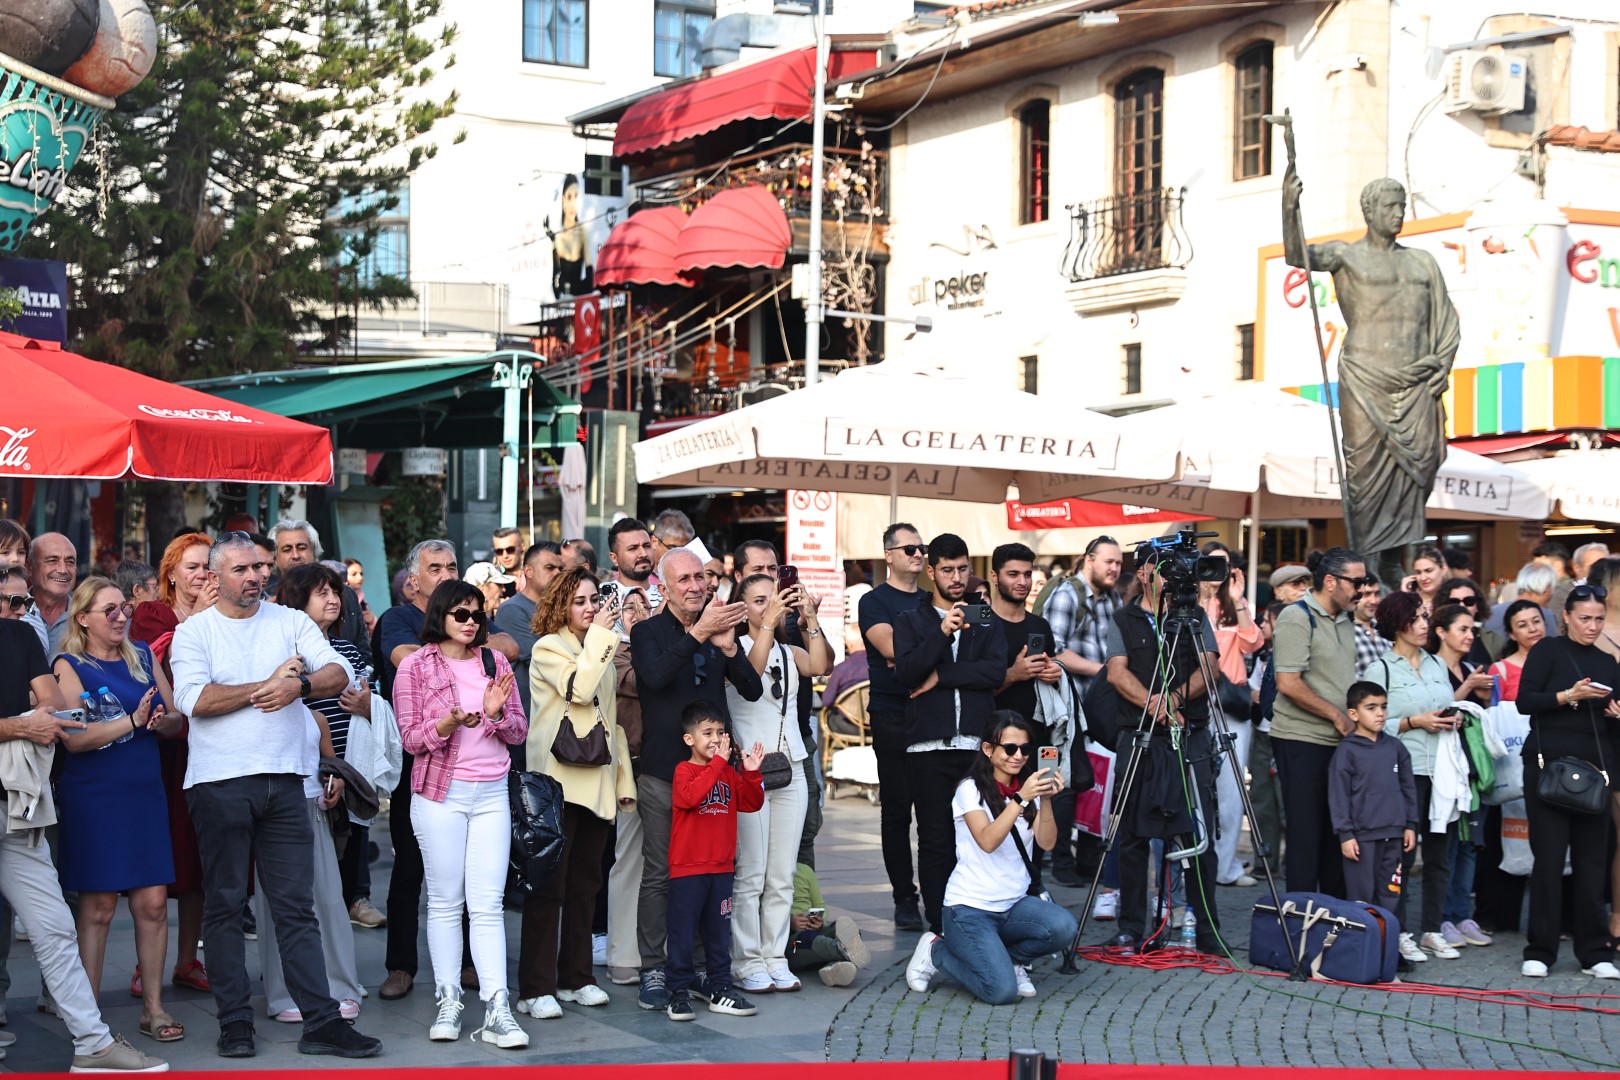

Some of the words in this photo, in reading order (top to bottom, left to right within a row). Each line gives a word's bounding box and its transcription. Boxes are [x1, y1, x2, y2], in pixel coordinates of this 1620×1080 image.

[935, 270, 988, 307] peker
[673, 428, 735, 458] GELATERIA
[845, 427, 885, 446] LA
[902, 430, 1097, 458] GELATERIA
